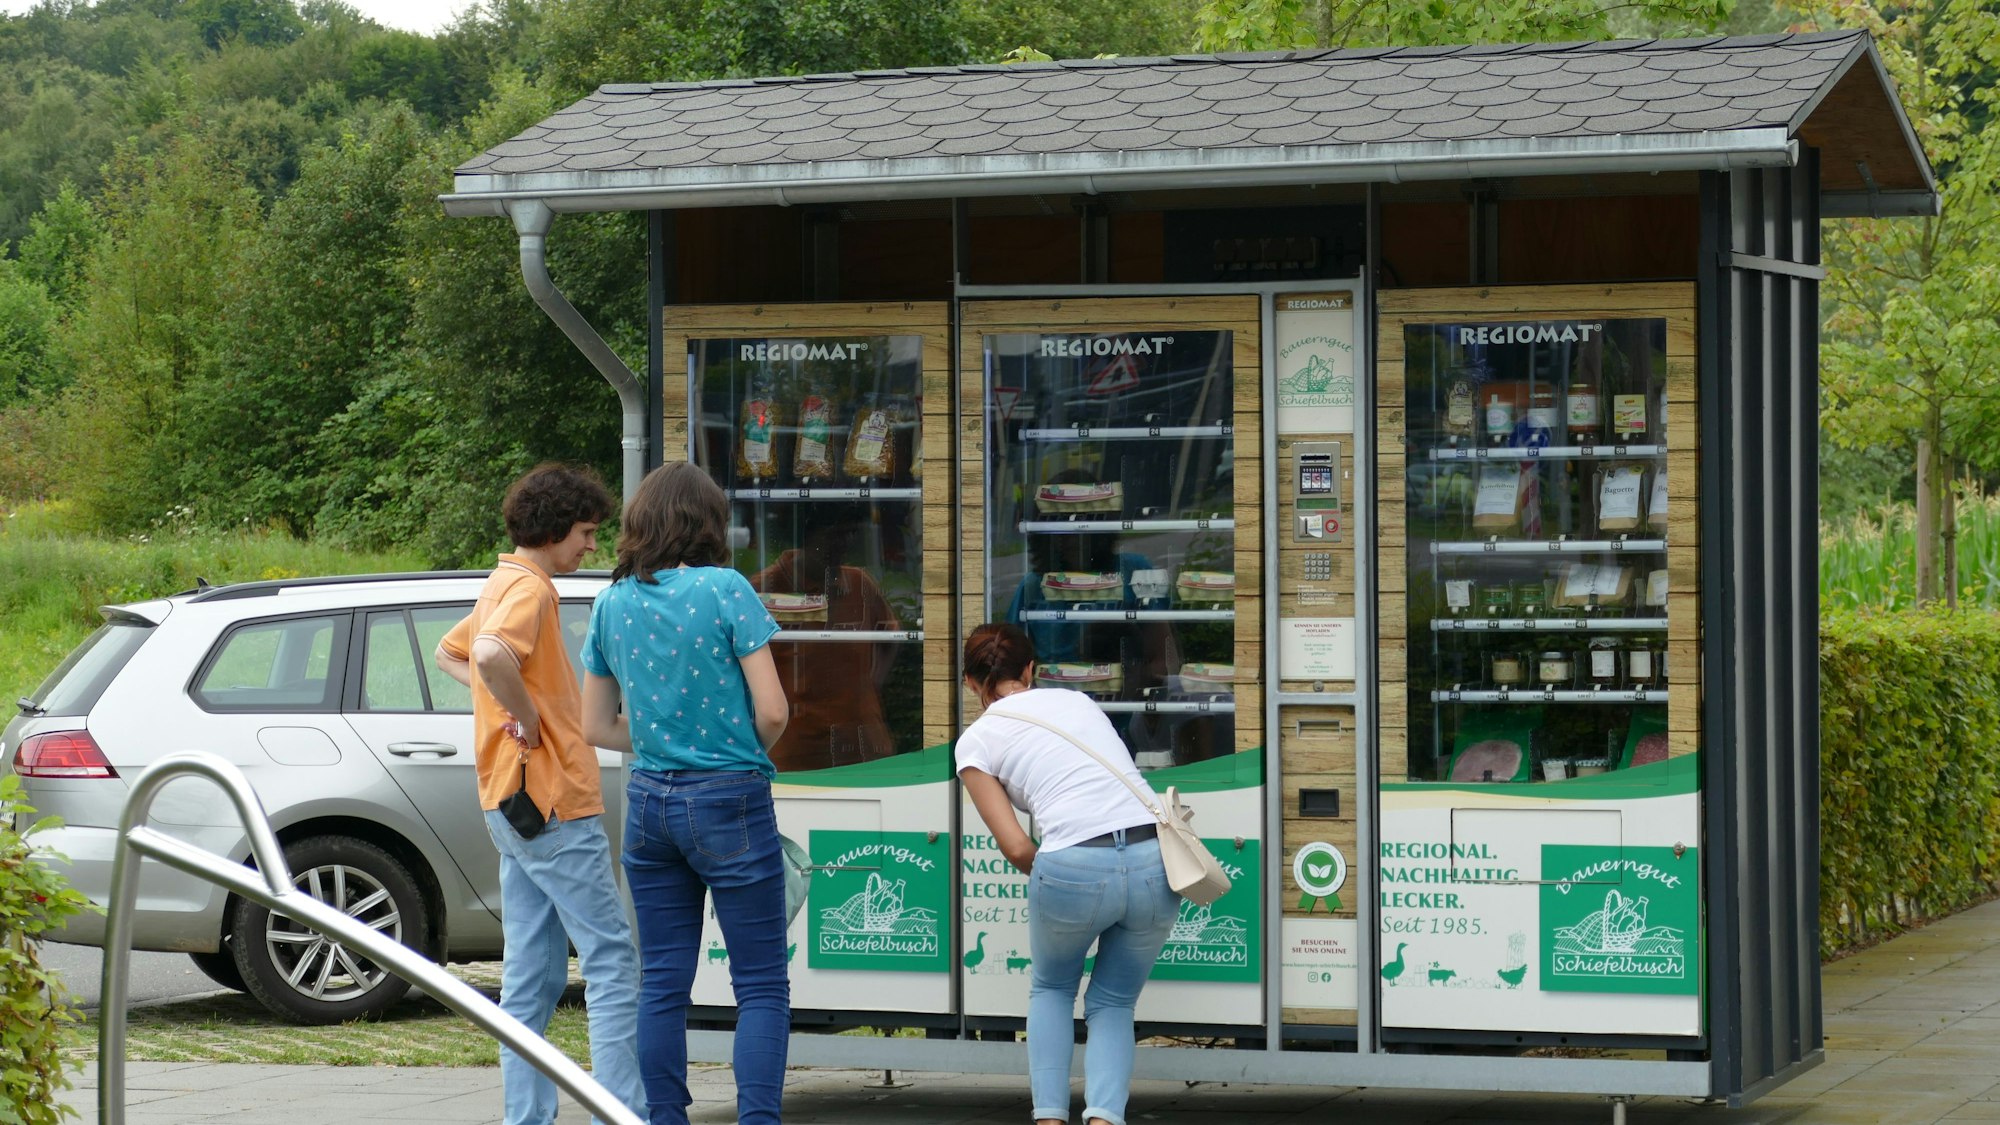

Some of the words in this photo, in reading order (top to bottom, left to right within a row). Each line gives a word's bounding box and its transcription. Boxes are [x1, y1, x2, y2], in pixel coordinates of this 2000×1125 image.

[1287, 299, 1344, 308] REGIOMAT
[1280, 335, 1353, 359] Bauerngut
[1280, 395, 1353, 407] Schiefelbusch
[1604, 486, 1635, 494] Baguette
[962, 834, 998, 850] REG
[1380, 842, 1498, 859] REGIONAL.
[823, 844, 936, 878] Bauerngut
[962, 858, 1023, 874] NACH
[1556, 859, 1682, 894] Bauerngut
[1380, 892, 1465, 909] LECKER.
[963, 906, 1005, 923] Seit
[1008, 907, 1030, 924] 19
[1380, 916, 1426, 934] Seit
[1430, 917, 1488, 935] 1985.
[821, 935, 938, 954] Schiefelbusch
[1300, 938, 1338, 946] BESUCHEN
[1157, 944, 1246, 963] efelbusch
[1555, 956, 1683, 975] Schiefelbusch
